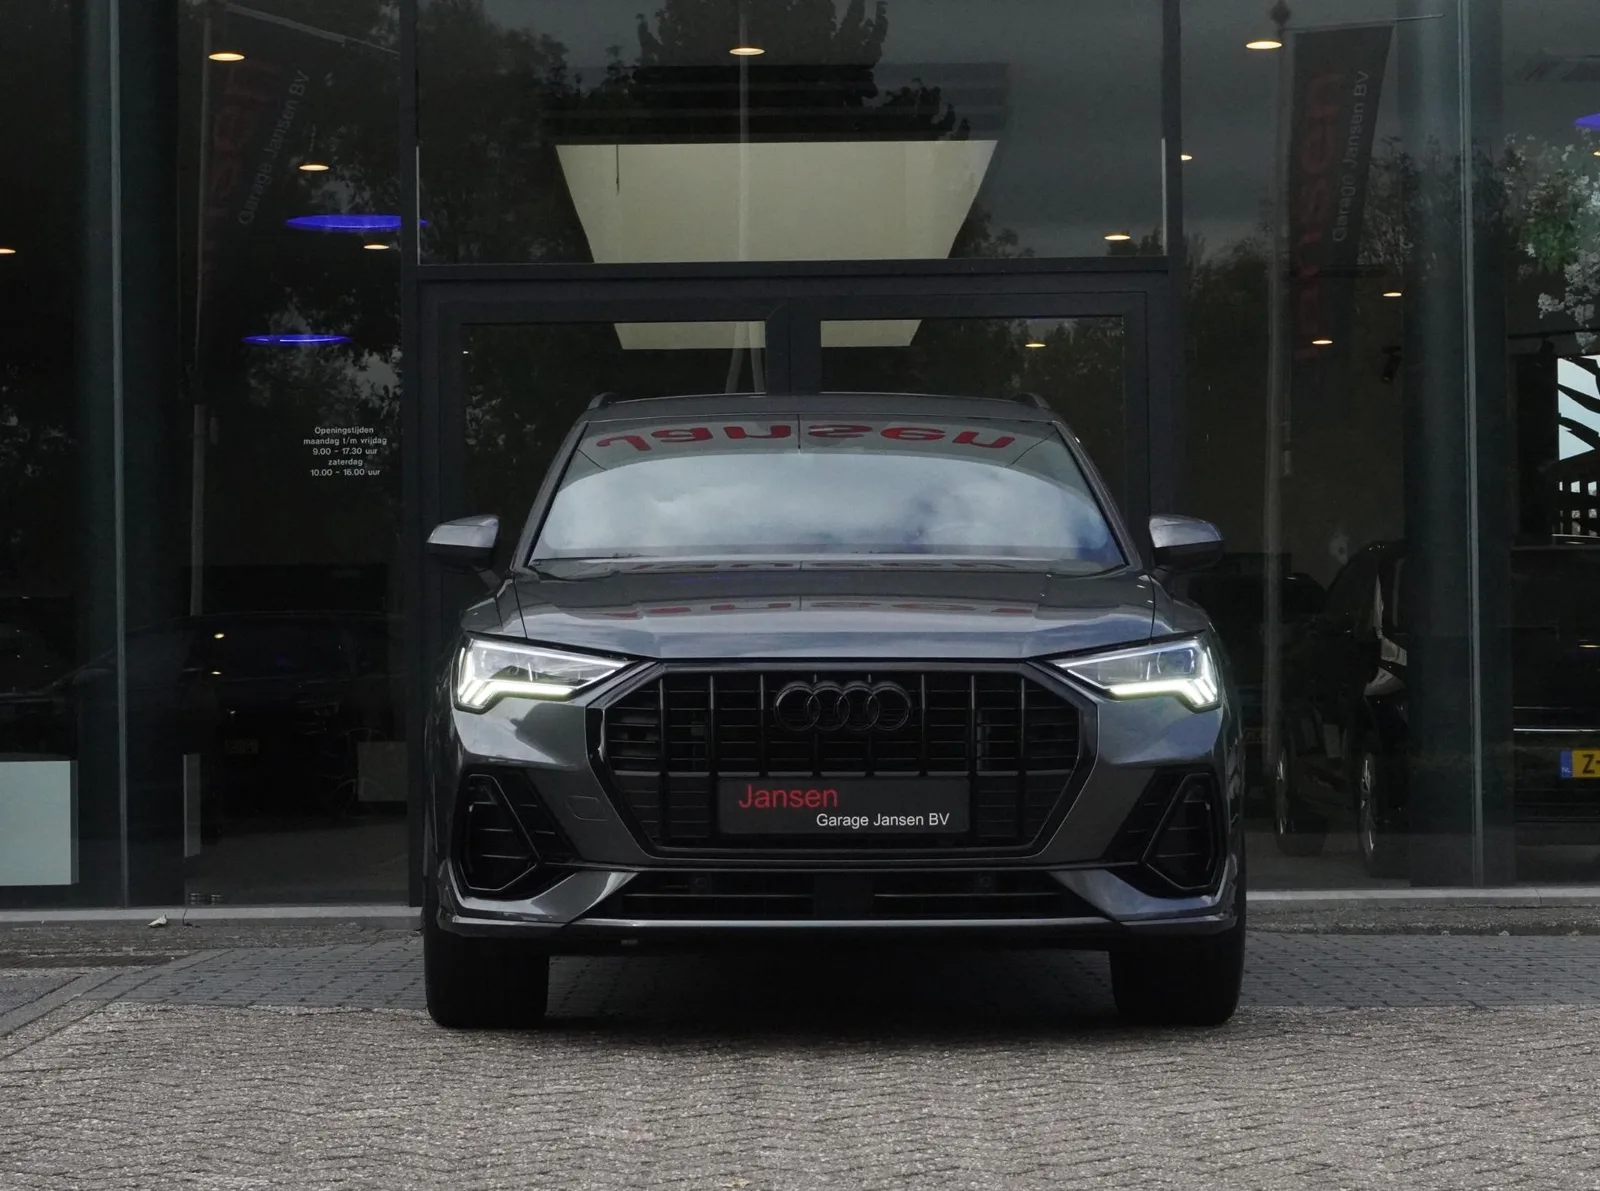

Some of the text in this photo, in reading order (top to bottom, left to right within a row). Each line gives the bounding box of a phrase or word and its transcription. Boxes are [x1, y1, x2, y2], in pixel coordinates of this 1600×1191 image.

[288, 69, 310, 96] BV
[1352, 70, 1370, 97] BV
[314, 426, 374, 435] Openingstijden
[303, 436, 387, 446] maandag t/m vrijdag
[342, 447, 363, 455] 17.30
[328, 458, 363, 466] zaterdag
[738, 784, 838, 809] Jansen
[816, 812, 950, 829] Garage Jansen BV
